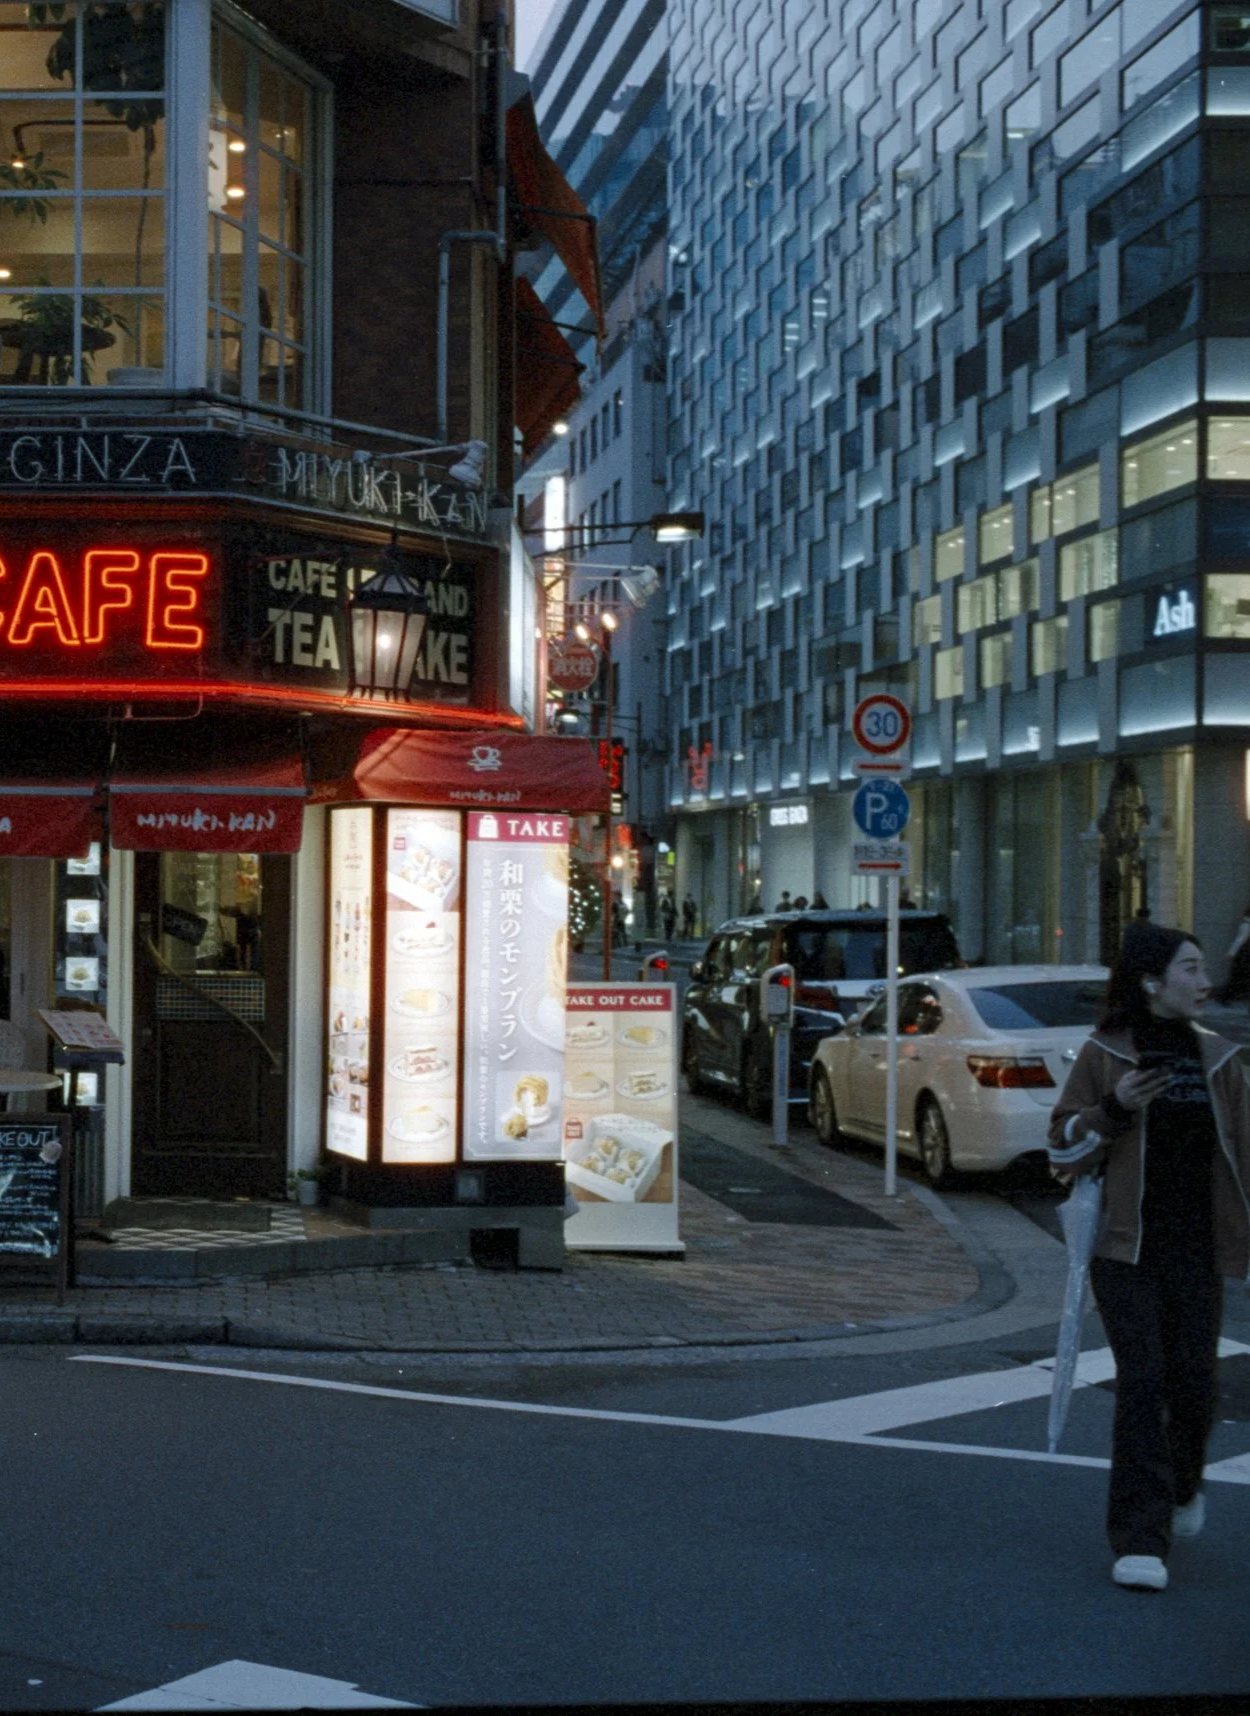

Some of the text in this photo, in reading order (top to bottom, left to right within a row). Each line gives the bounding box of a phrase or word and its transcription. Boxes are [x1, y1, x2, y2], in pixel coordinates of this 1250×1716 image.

[10, 434, 197, 484] GINZA
[410, 576, 470, 618] AND
[1153, 590, 1196, 636] Ash
[267, 607, 470, 686] TEA KE
[553, 652, 594, 677] 消火栓
[866, 711, 899, 738] 30
[507, 818, 564, 837] TAKE
[865, 791, 890, 830] P
[498, 859, 525, 1062] 和栗のモンブラン
[598, 995, 626, 1006] OUT
[629, 995, 664, 1006] CAKE
[17, 1129, 49, 1147] OUT
